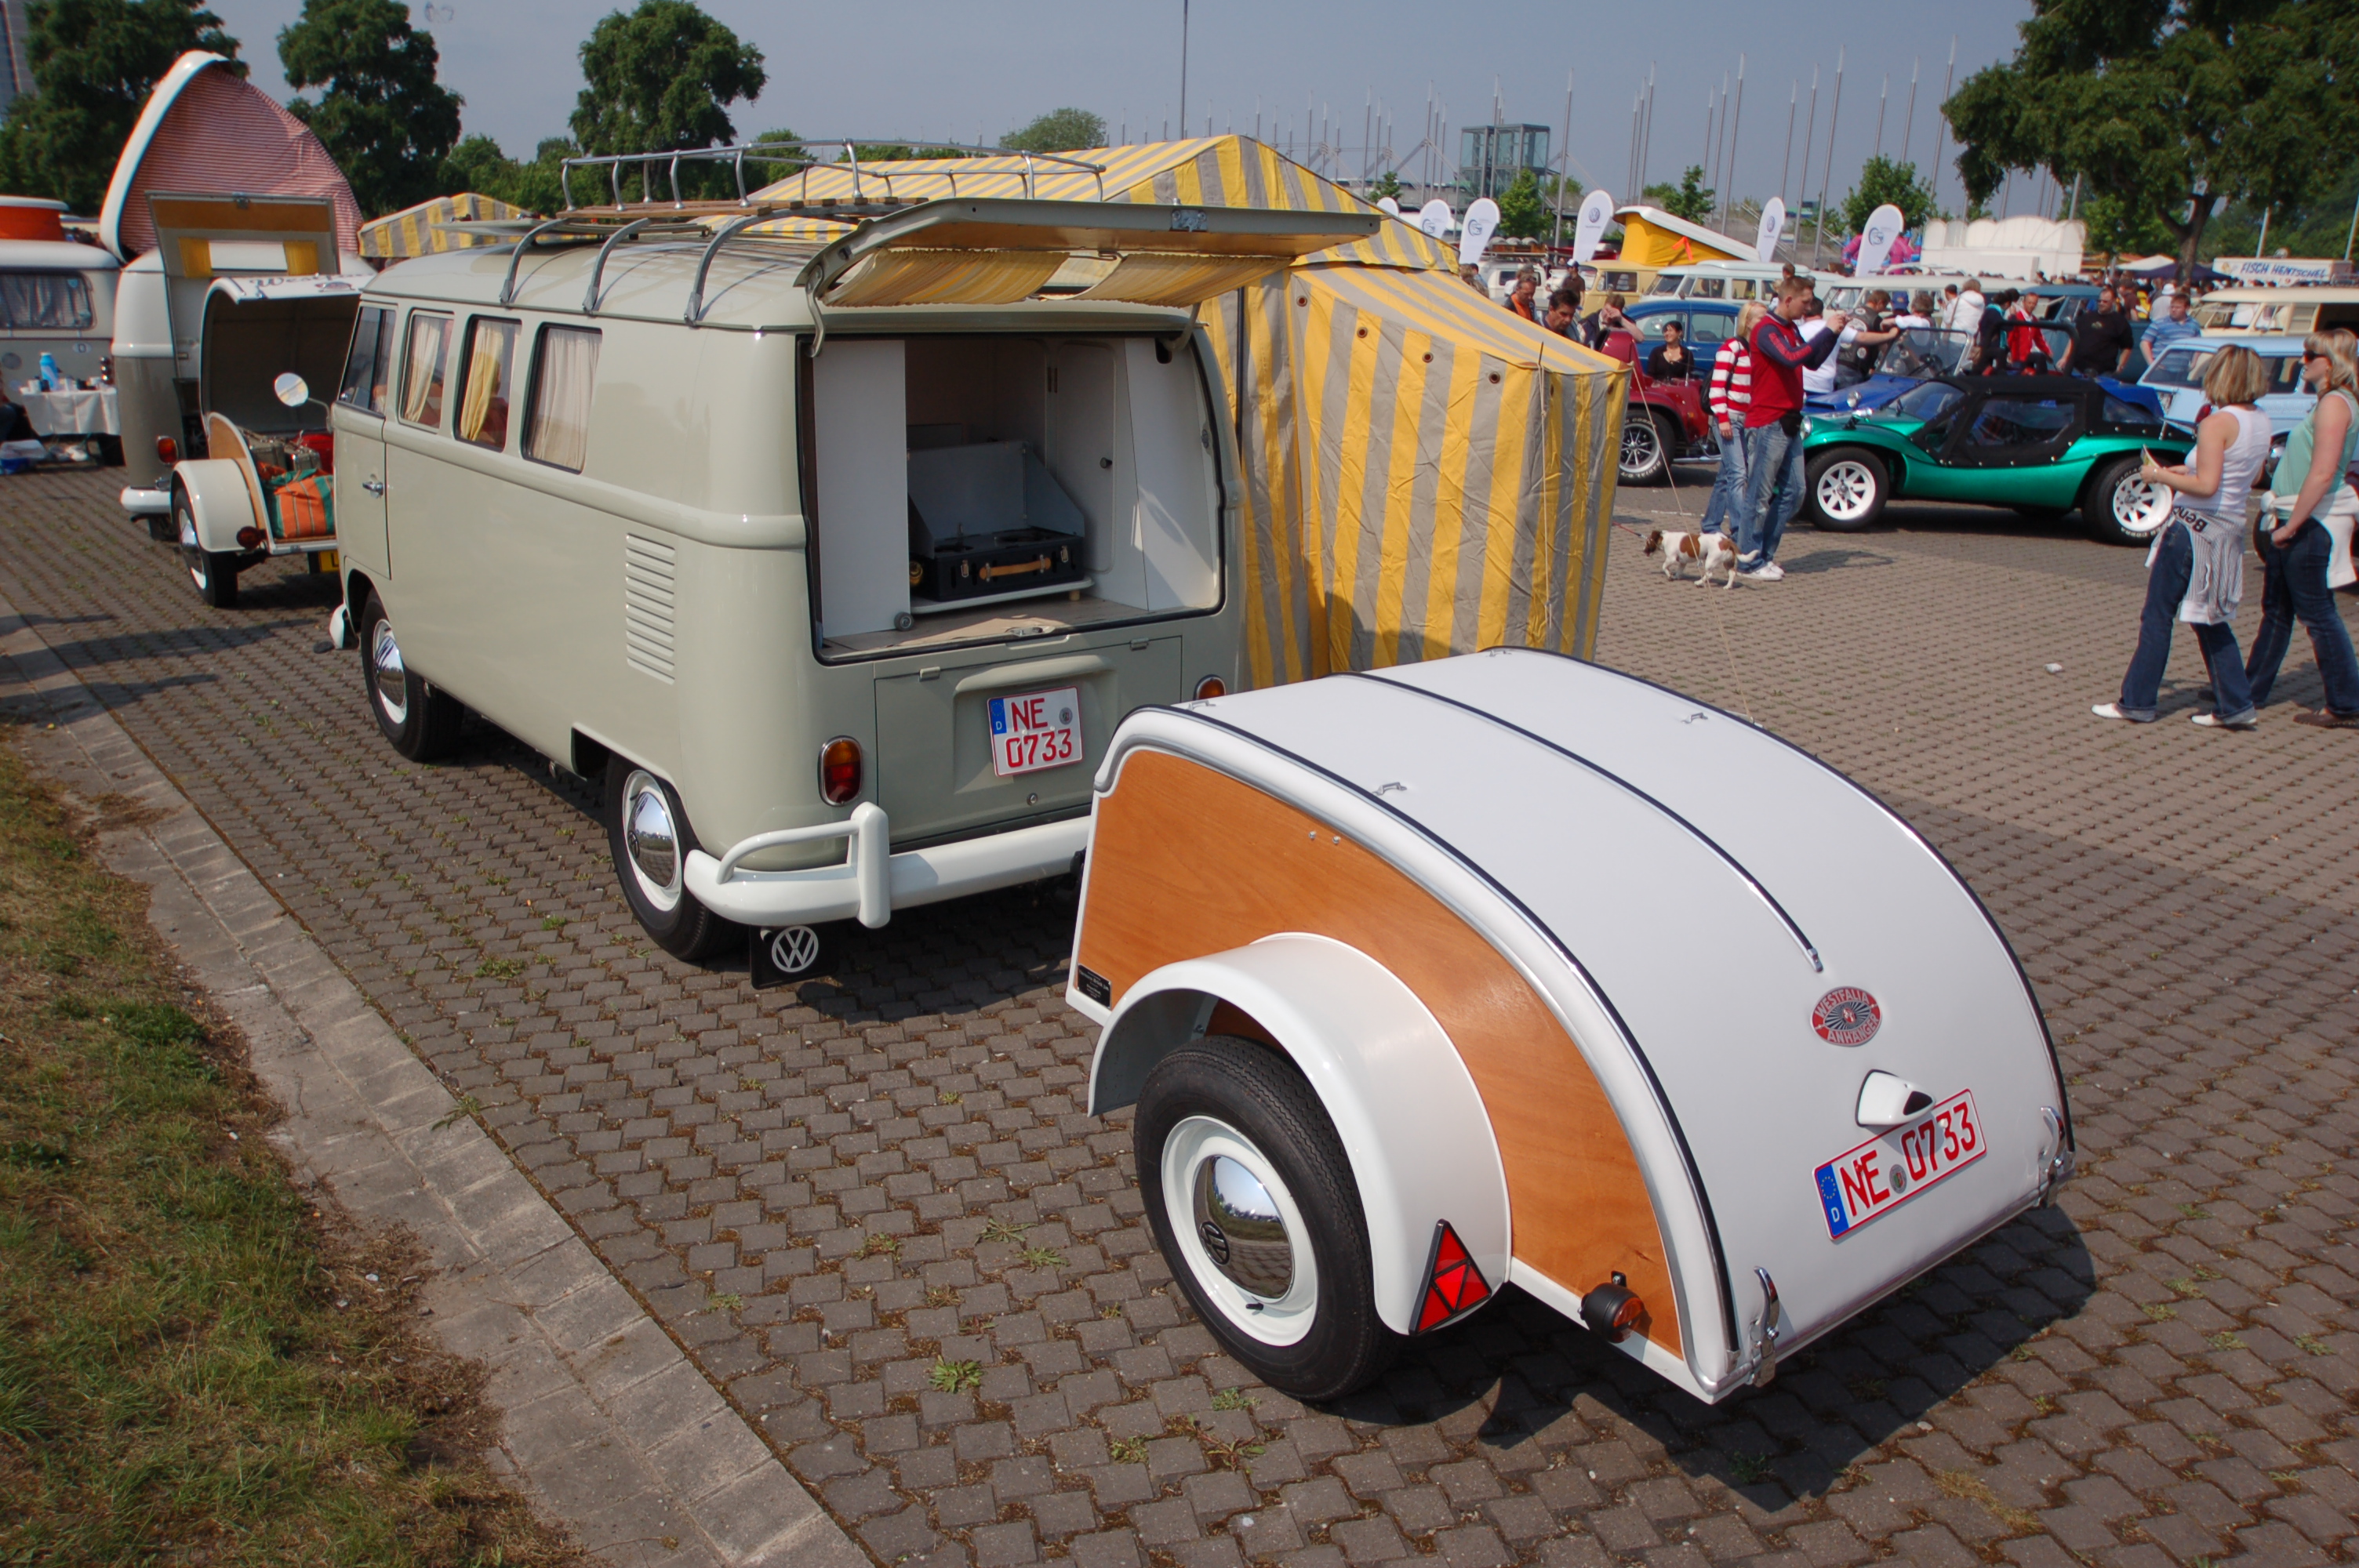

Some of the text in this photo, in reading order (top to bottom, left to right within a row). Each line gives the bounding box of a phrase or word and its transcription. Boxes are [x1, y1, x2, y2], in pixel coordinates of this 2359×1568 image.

[2241, 262, 2326, 278] FISCH HENTSCHEL
[995, 697, 1049, 732] D NE
[1005, 728, 1073, 768] 0733
[1814, 989, 1870, 1018] WESTFALIA
[1830, 1101, 1976, 1222] D NE 0733
